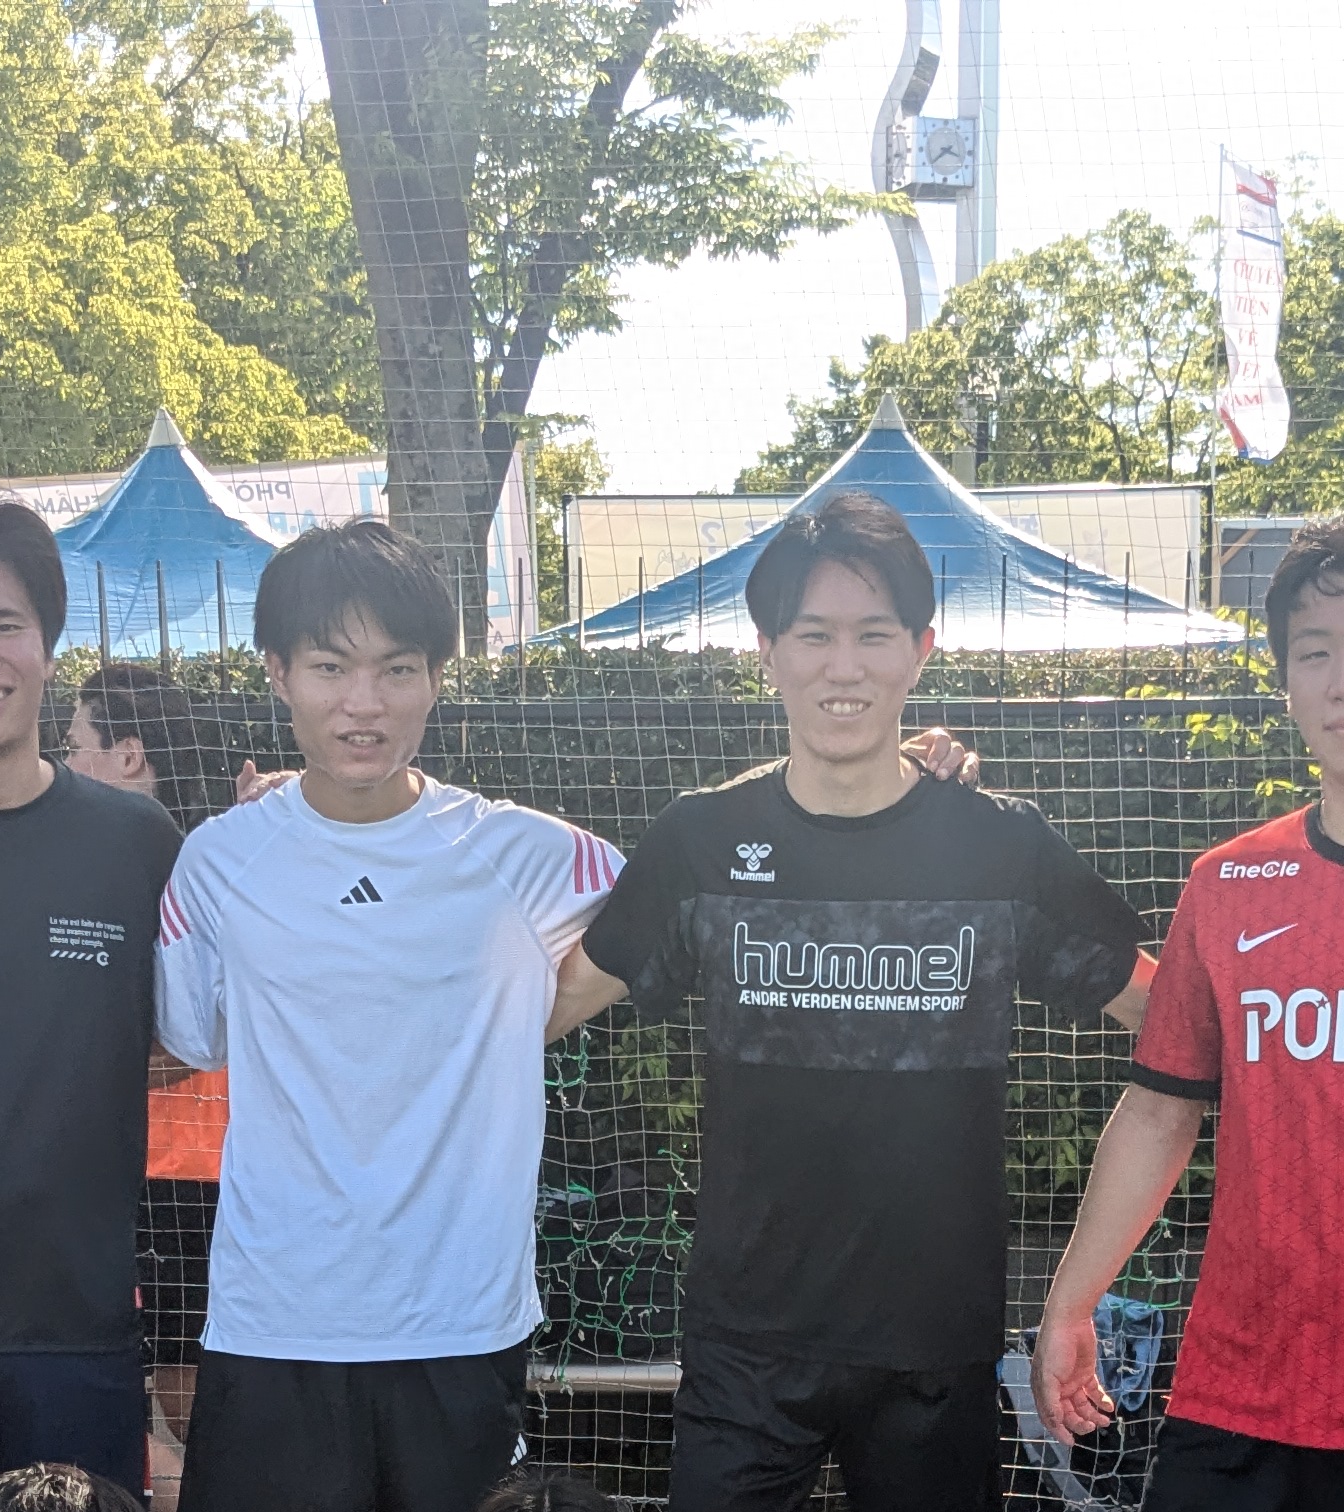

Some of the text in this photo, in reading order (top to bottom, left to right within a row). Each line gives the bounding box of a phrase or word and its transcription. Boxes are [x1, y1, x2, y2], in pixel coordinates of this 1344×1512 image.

[730, 867, 776, 883] hummel
[1219, 860, 1301, 880] EneCle
[733, 921, 975, 992] hummel
[791, 992, 852, 1010] VERDEN
[854, 995, 920, 1011] GENNEM
[921, 995, 968, 1012] SPORT
